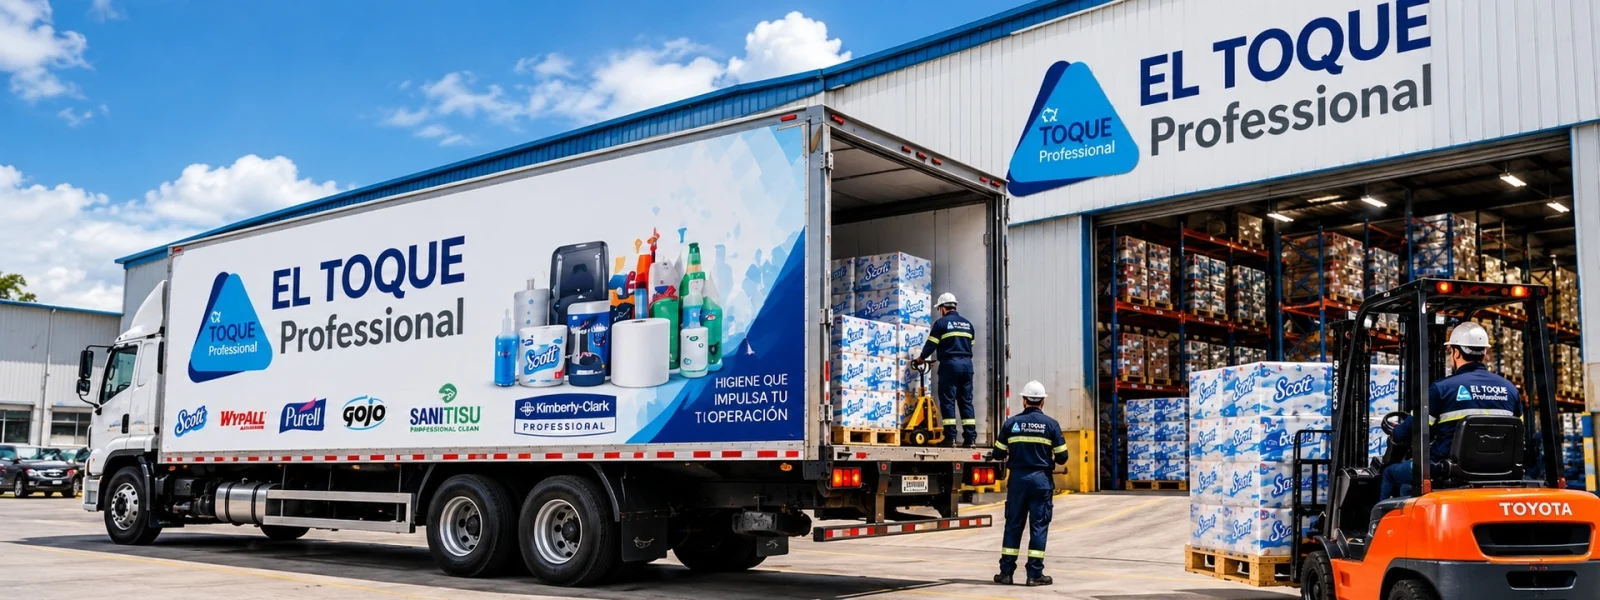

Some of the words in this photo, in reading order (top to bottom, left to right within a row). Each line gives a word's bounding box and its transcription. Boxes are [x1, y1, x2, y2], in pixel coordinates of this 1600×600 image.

[1141, 50, 1200, 106] EL
[1213, 0, 1432, 90] TOQUE
[1151, 63, 1432, 156] Professional
[1039, 117, 1112, 146] TOQUE
[1039, 140, 1115, 163] Professional
[272, 266, 311, 310] EL
[320, 235, 465, 302] TOQUE
[209, 321, 256, 343] TOQUE
[280, 297, 464, 354] Professional
[208, 341, 258, 356] Professional
[715, 375, 760, 389] HIGIENE
[763, 373, 788, 387] QUE
[714, 391, 768, 406] IMPULSA
[771, 390, 788, 403] TU
[176, 405, 206, 434] Scott
[285, 406, 321, 427] Purell
[410, 406, 481, 426] SANITISU
[1499, 502, 1573, 516] TOYOTA
